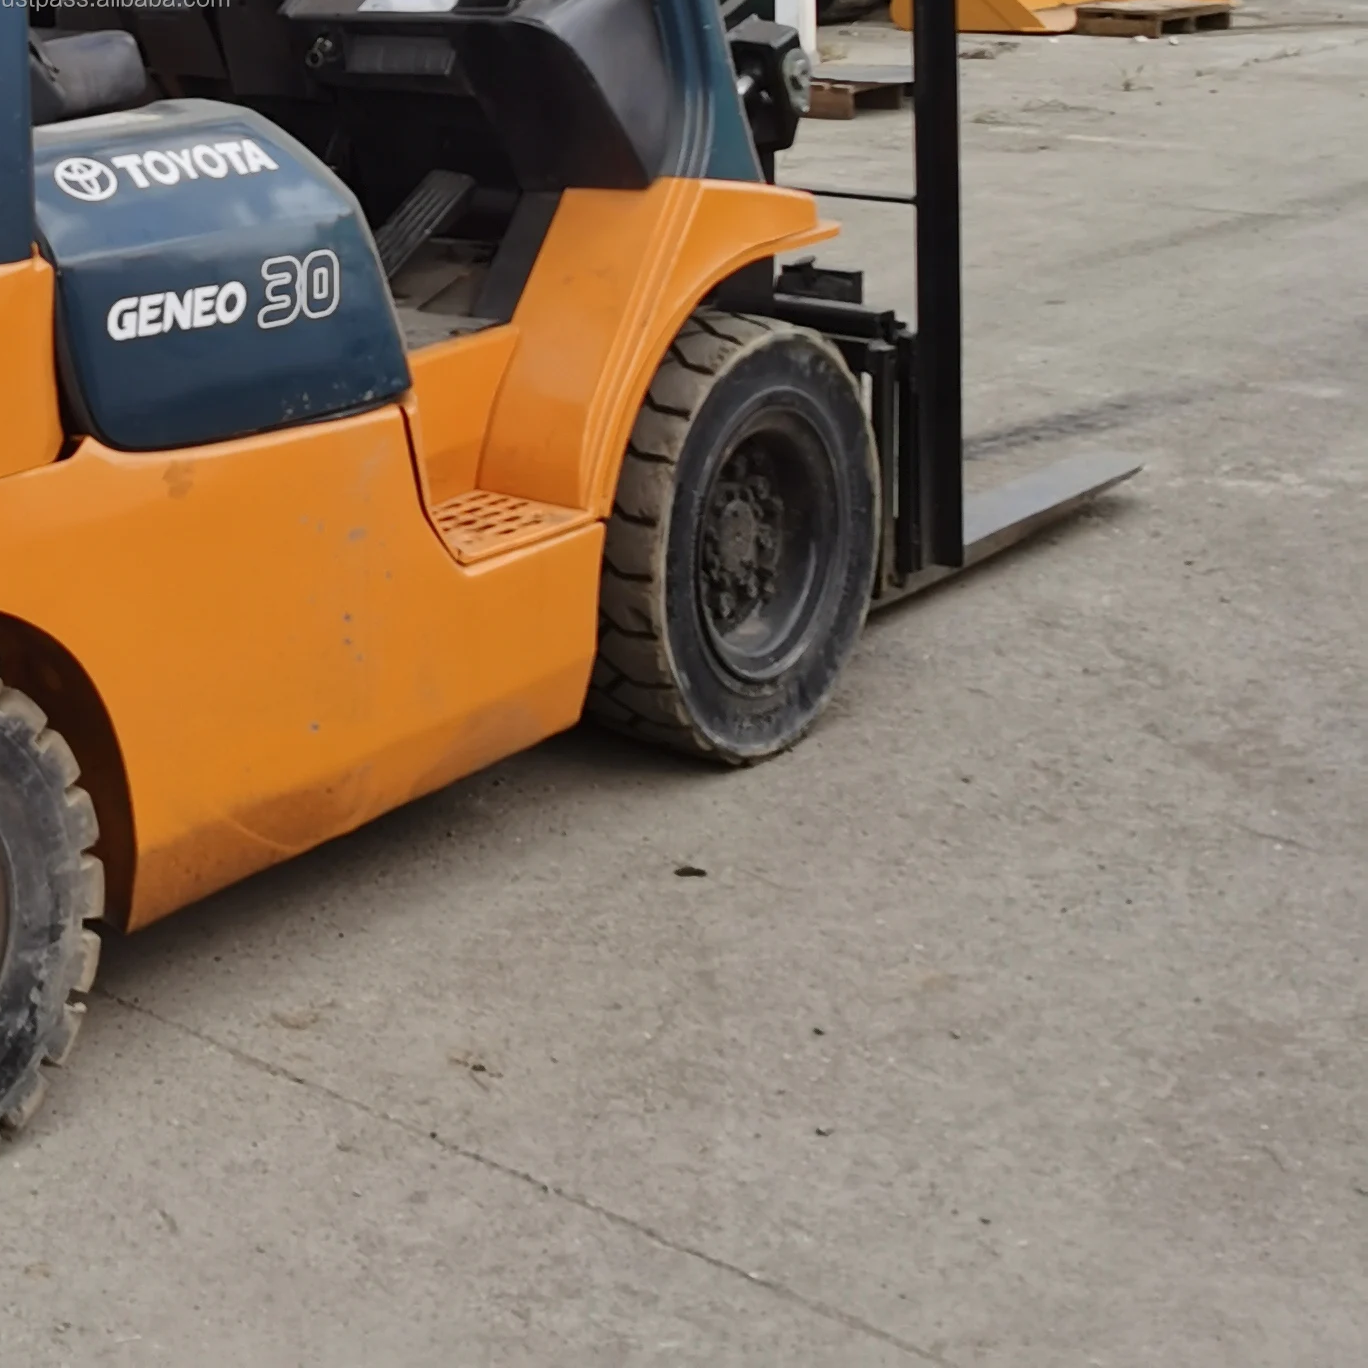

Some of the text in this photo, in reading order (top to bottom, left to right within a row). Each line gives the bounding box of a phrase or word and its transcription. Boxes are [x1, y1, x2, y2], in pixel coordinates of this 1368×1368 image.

[111, 139, 279, 188] TOYOTA
[107, 248, 340, 341] GENEO 30
